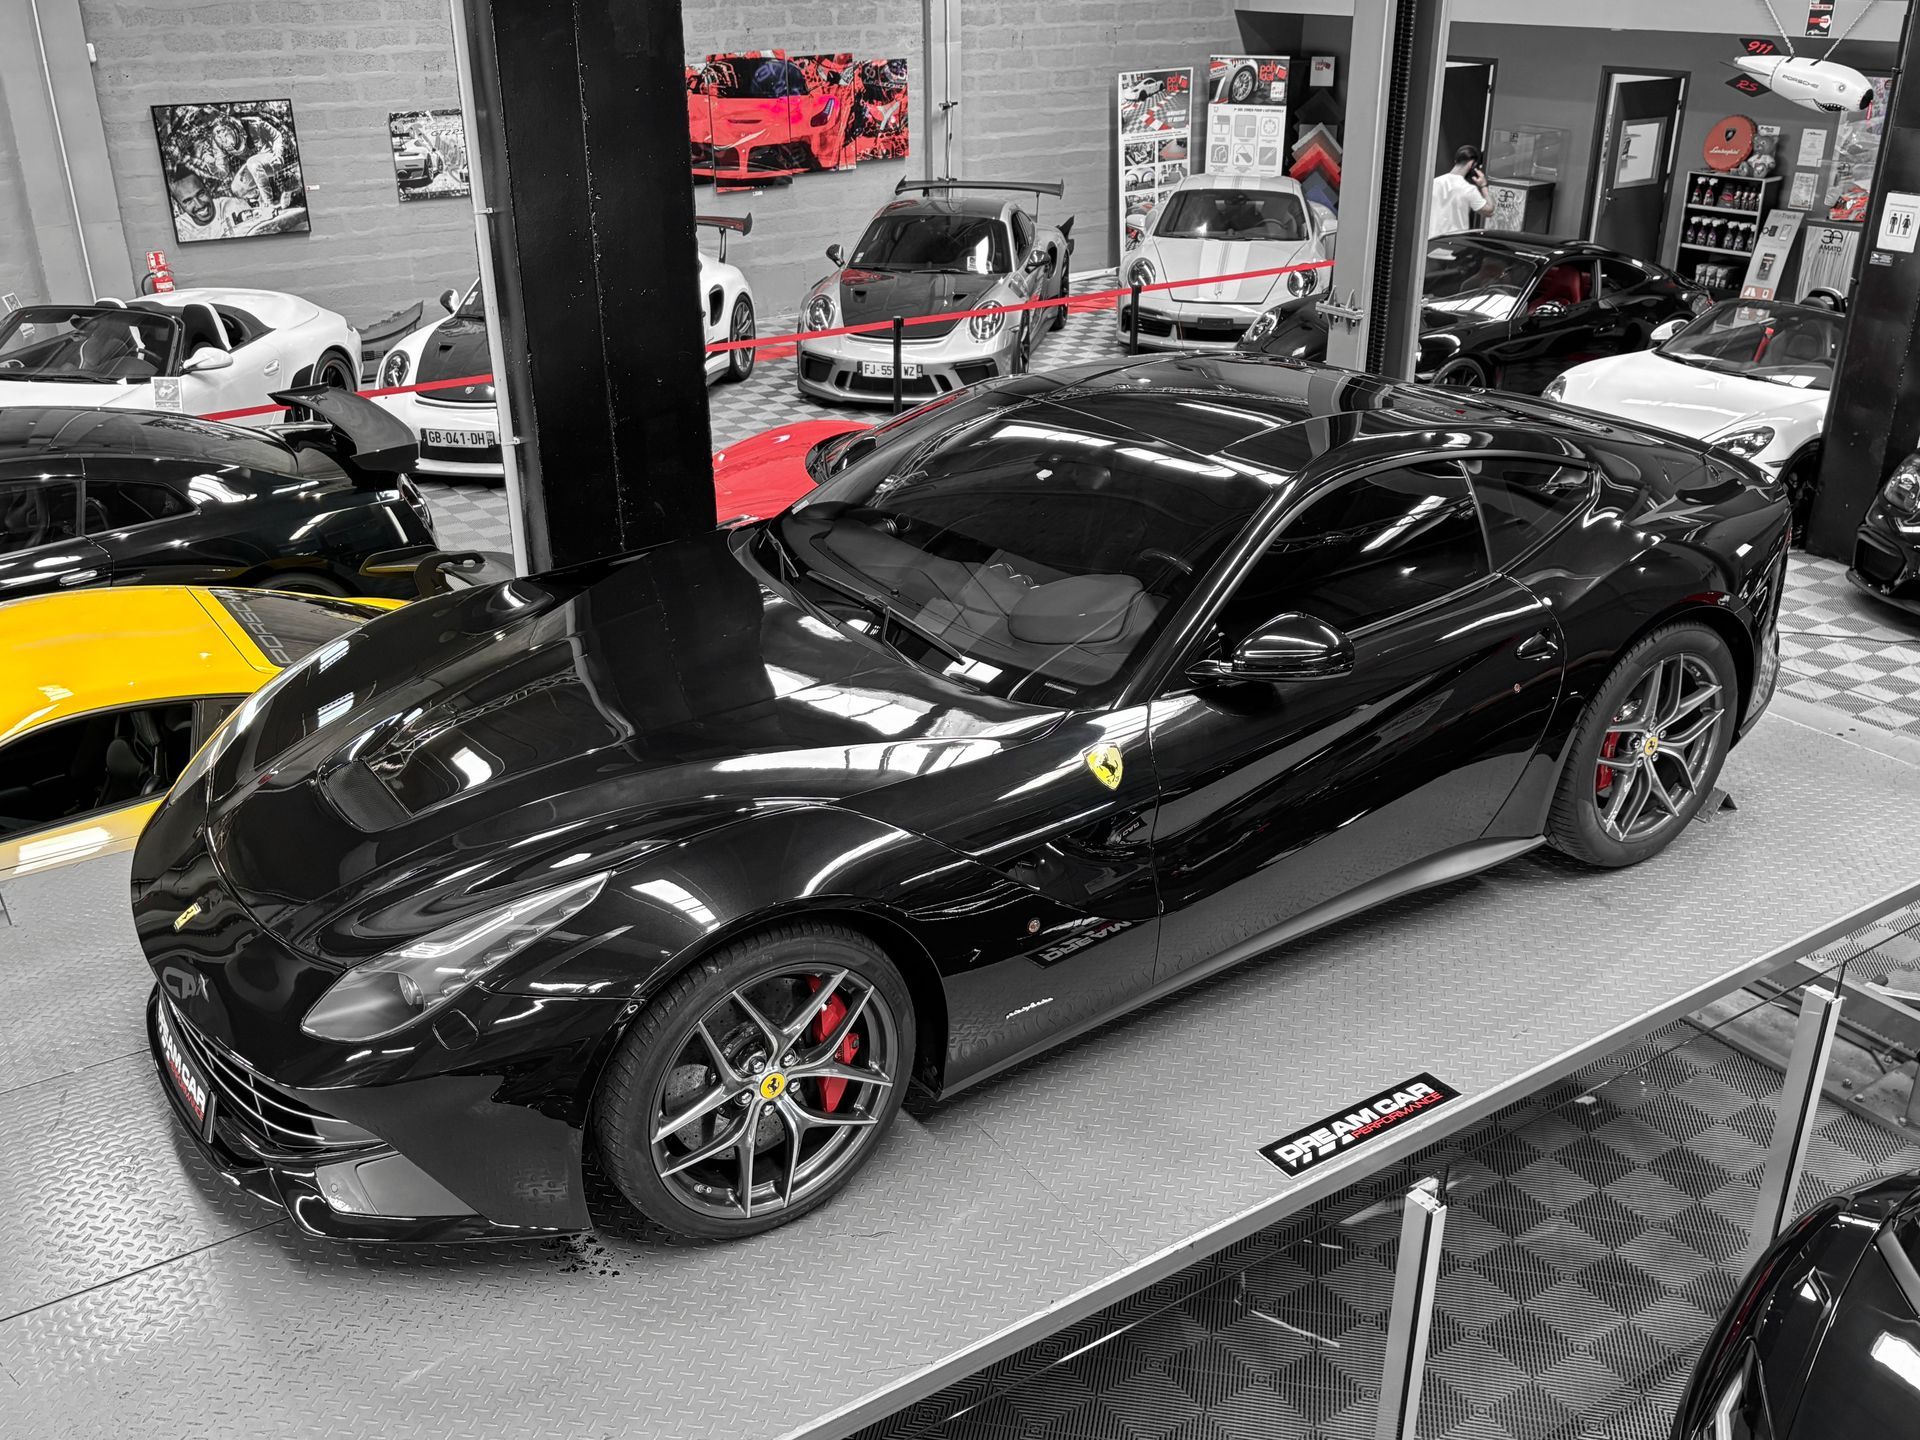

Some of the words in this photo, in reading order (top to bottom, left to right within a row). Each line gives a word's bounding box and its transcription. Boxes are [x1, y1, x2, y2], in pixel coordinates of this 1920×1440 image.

[1748, 41, 1774, 54] 911
[1736, 80, 1759, 92] RS
[1782, 74, 1819, 90] PORSCHE
[428, 431, 486, 445] GB-041-DH
[181, 1063, 206, 1115] CAR
[1351, 1090, 1443, 1139] PERFORMANCE
[1274, 1107, 1380, 1167] DREAM
[1373, 1082, 1435, 1115] CAR
